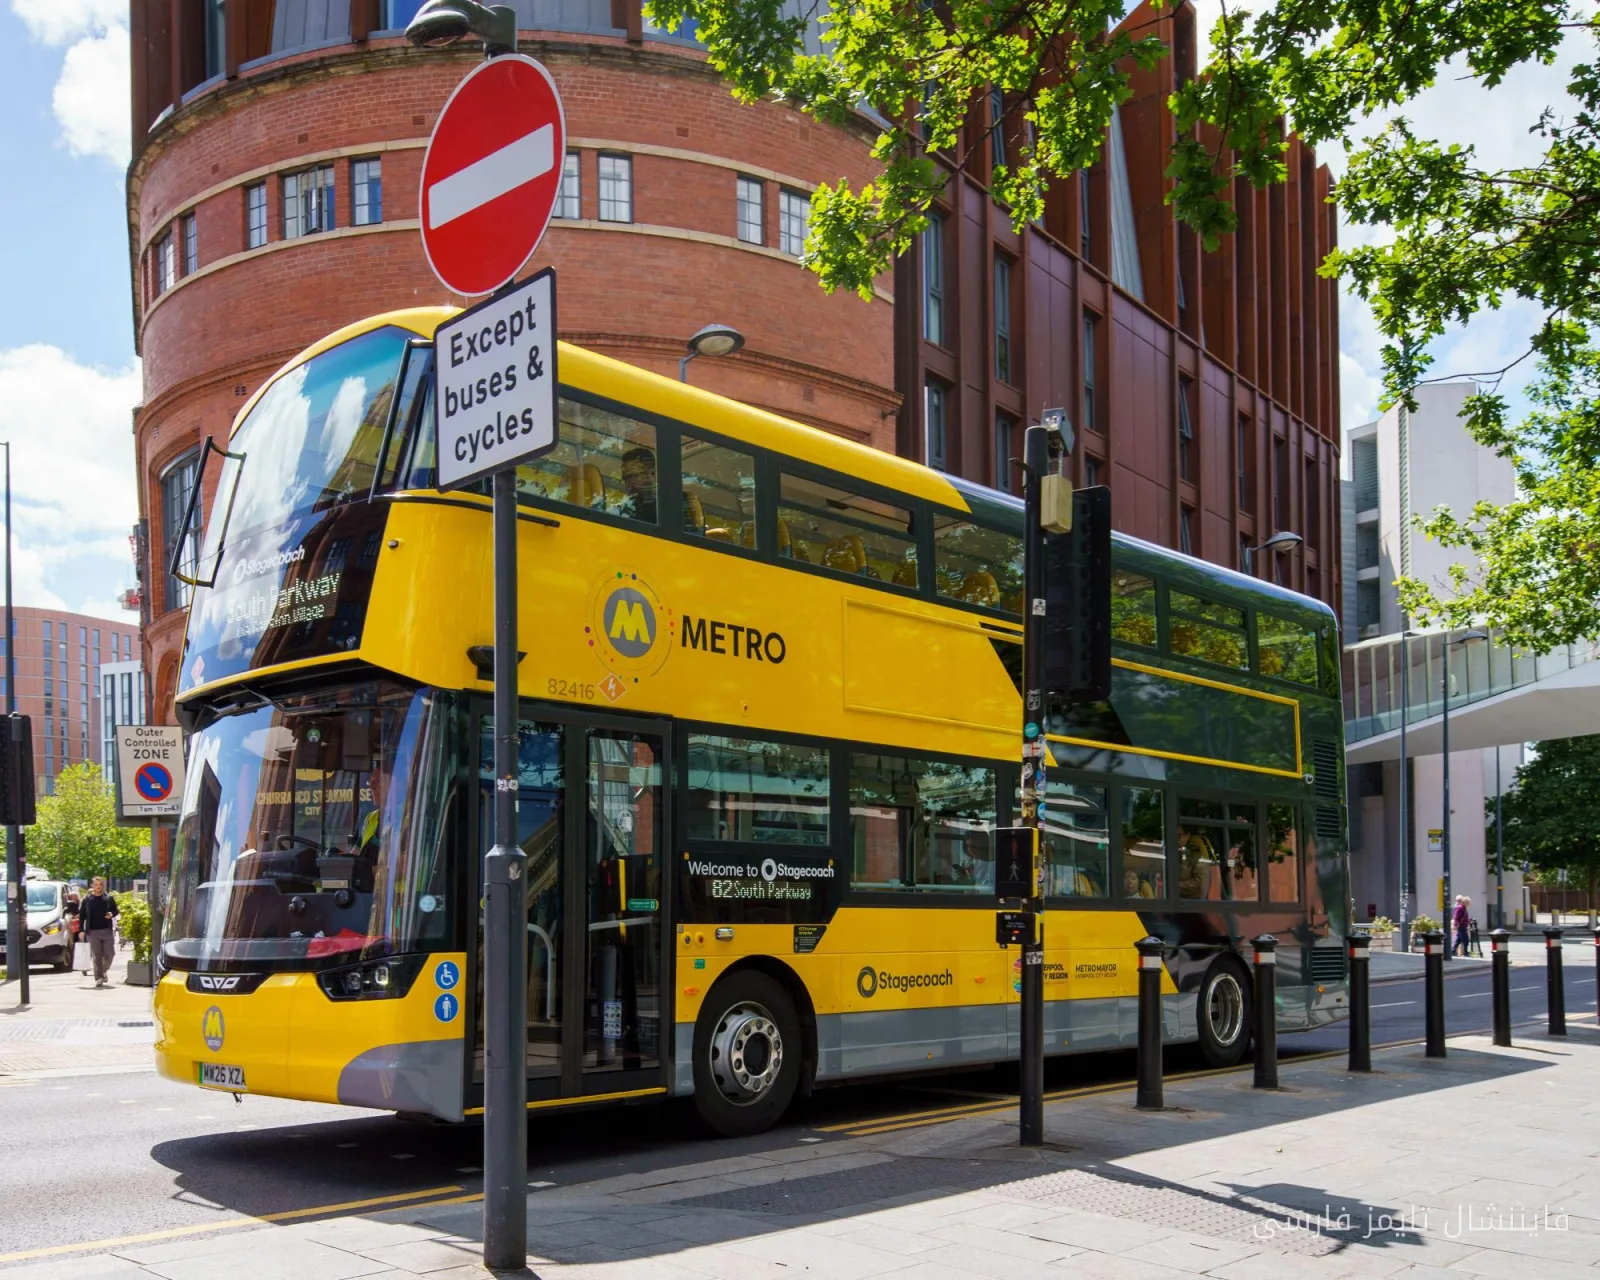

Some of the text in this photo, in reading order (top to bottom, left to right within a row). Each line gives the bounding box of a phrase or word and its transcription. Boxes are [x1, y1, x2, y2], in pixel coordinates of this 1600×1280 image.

[451, 296, 536, 368] Except
[445, 345, 544, 418] buses &
[454, 407, 534, 464] cycles
[246, 545, 305, 573] Stagecoach
[270, 573, 340, 608] Parkway
[681, 614, 786, 664] METRO
[547, 678, 595, 700] 82416
[124, 738, 177, 747] Controlled
[135, 728, 164, 737] Outer
[133, 749, 170, 759] ZONE
[312, 788, 373, 804] STAKHOSE
[688, 860, 834, 879] Welcome to Stagecoach
[711, 880, 811, 900] 82 South Parkway
[1043, 964, 1064, 972] ERPOOL
[1049, 972, 1069, 980] REGION
[879, 969, 953, 993] Stagecoach
